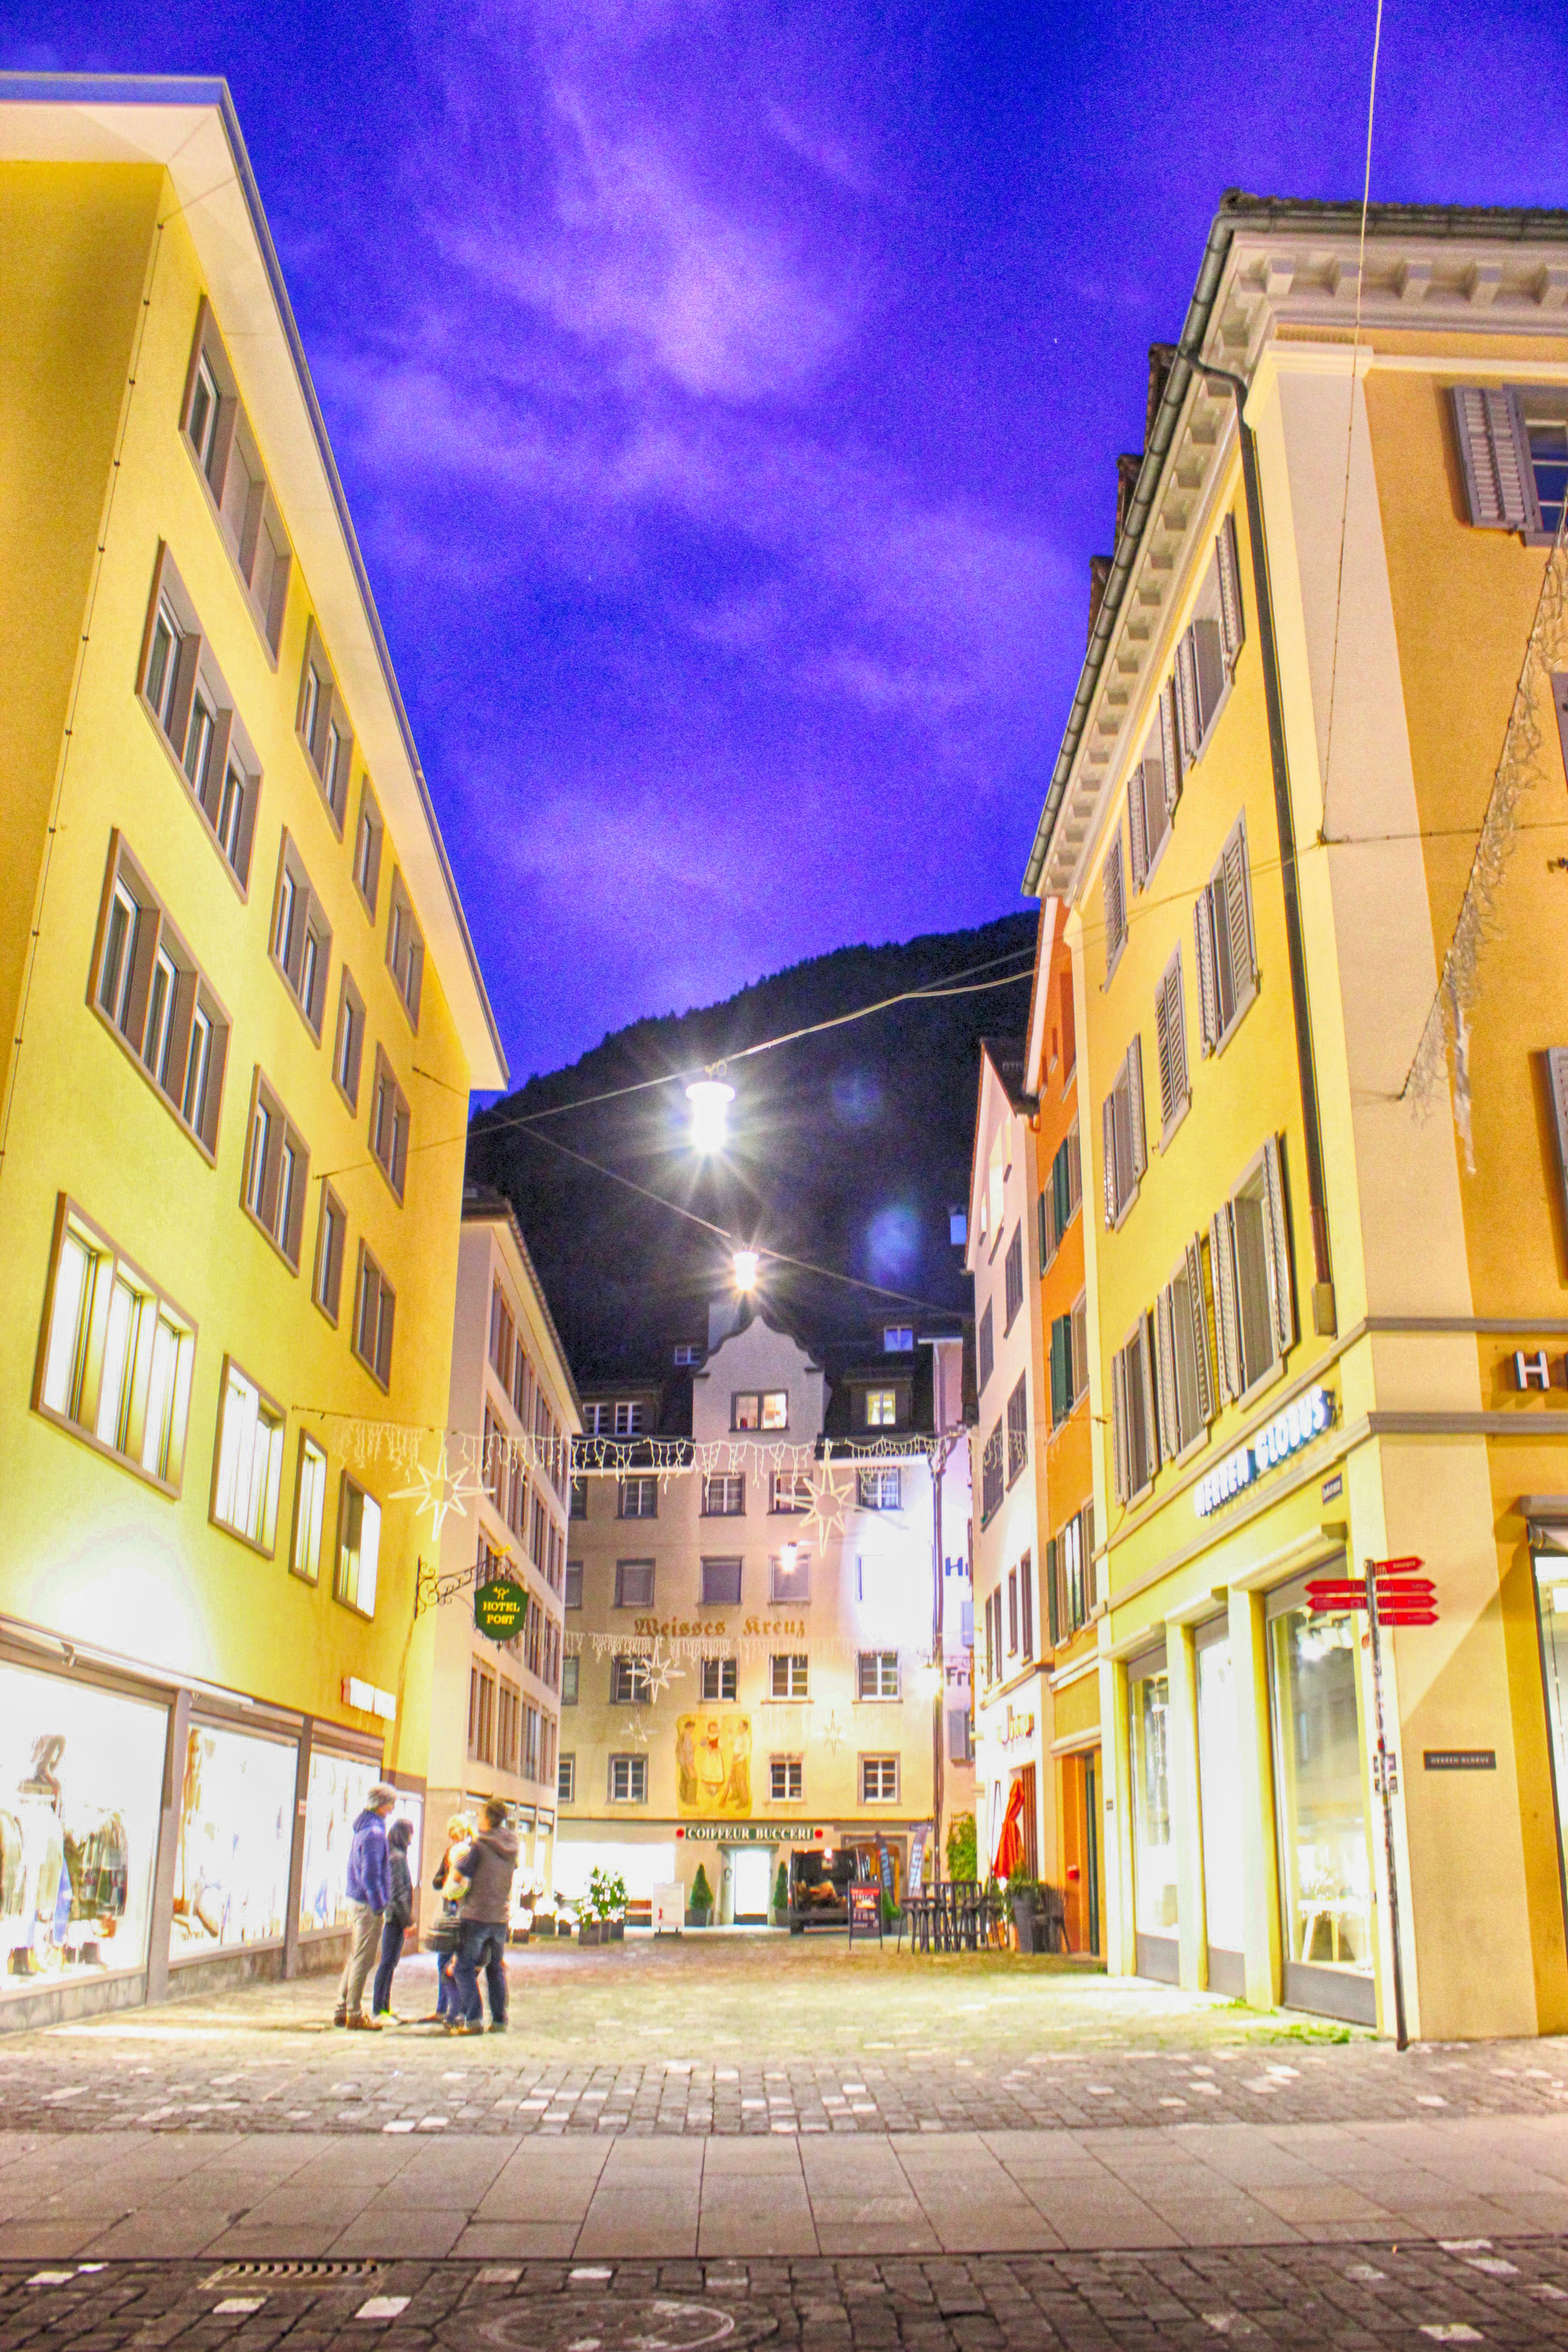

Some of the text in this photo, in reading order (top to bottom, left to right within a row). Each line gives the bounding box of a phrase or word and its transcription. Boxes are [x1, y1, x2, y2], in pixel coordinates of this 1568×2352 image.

[1513, 1349, 1568, 1390] H
[1255, 1385, 1324, 1470] GLOBUS
[482, 1601, 520, 1612] HOTEL
[486, 1614, 514, 1625] POST
[634, 1615, 805, 1638] Weisses Kreuz
[687, 1828, 811, 1840] COIFFEUR BUCCERI
